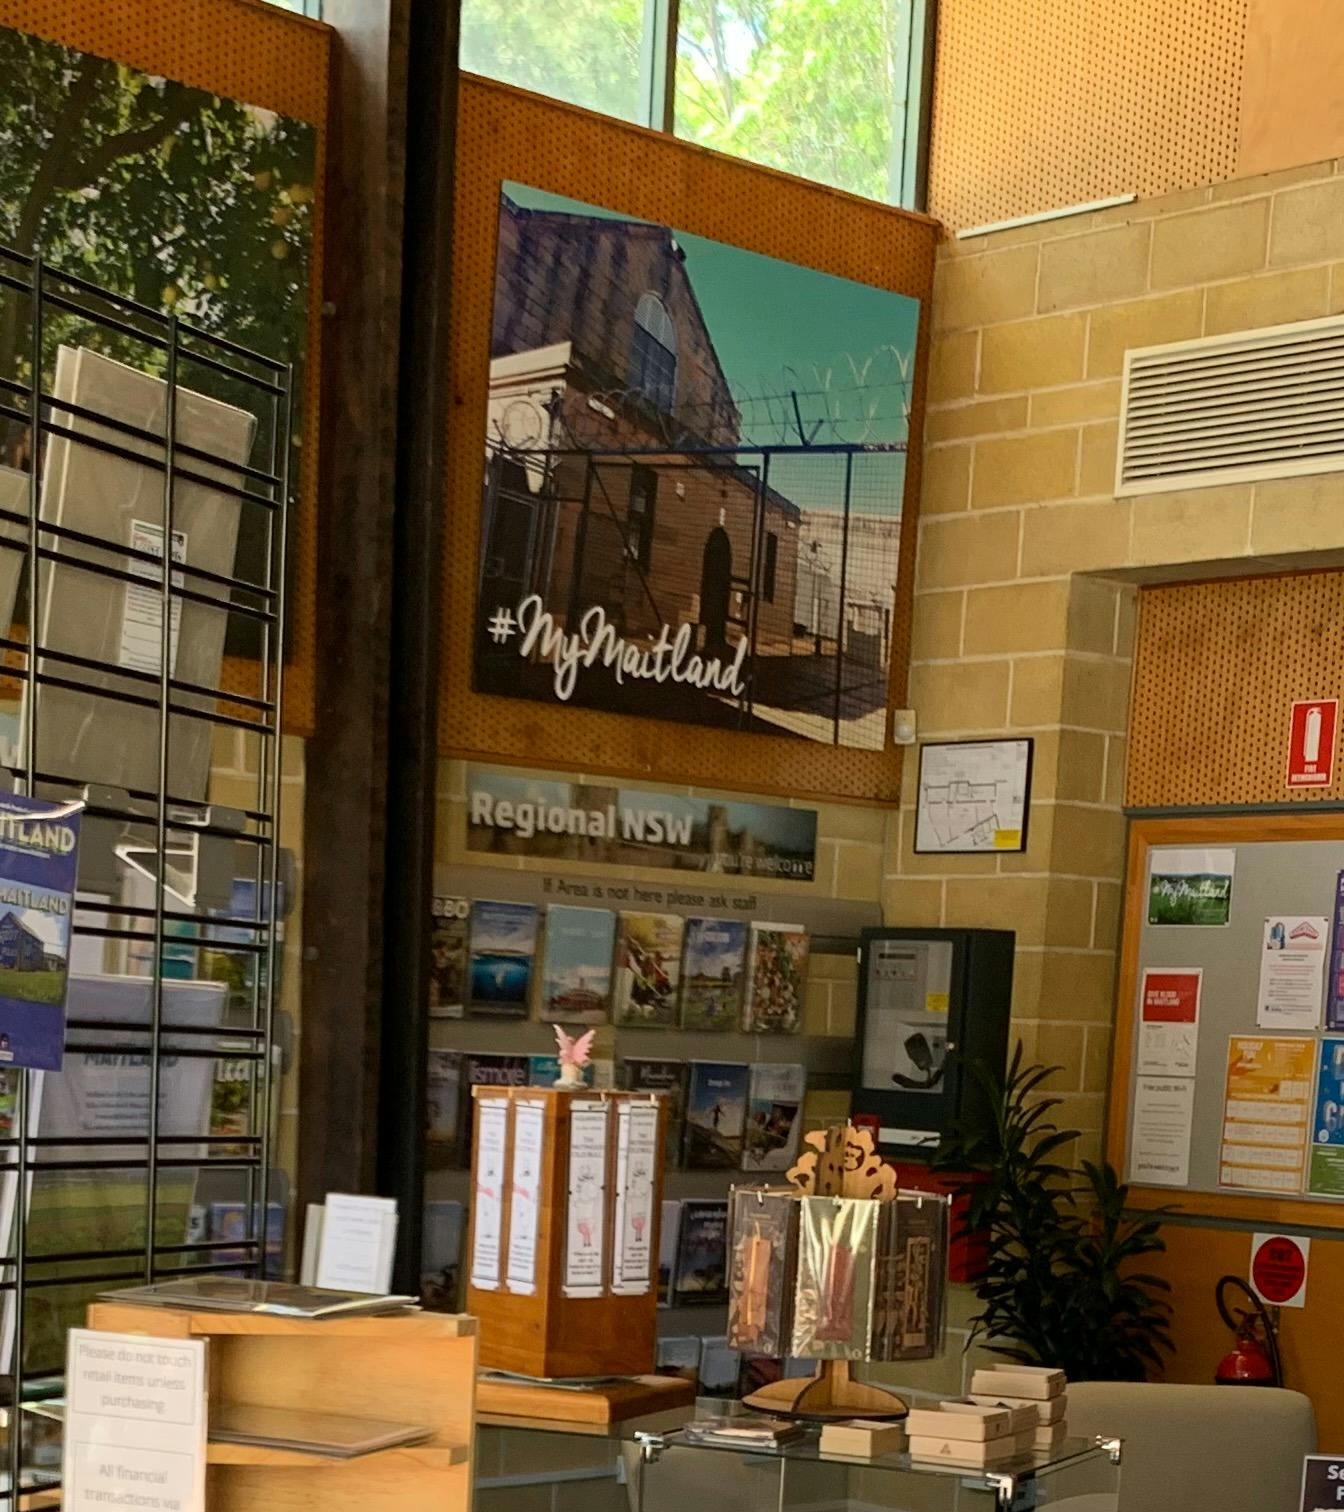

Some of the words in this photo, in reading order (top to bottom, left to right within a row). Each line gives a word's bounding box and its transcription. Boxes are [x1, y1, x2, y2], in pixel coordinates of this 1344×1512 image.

[487, 594, 749, 701] #MyMaitland
[470, 791, 616, 838] Regional
[623, 807, 694, 846] NSW
[557, 880, 590, 898] Area
[593, 884, 604, 899] is
[608, 886, 630, 901] not
[634, 887, 662, 904] here
[667, 889, 705, 910] please
[709, 893, 728, 909] ask
[732, 894, 758, 910] staff
[79, 1344, 114, 1362] Please
[118, 1346, 133, 1362] do
[135, 1348, 156, 1364] not
[158, 1349, 192, 1368] touch
[113, 1370, 144, 1388] items
[148, 1374, 186, 1391] unless
[101, 1393, 166, 1414] purchasing
[99, 1463, 114, 1478] All
[117, 1465, 168, 1484] financial
[84, 1488, 161, 1508] transactions
[164, 1498, 181, 1511] via
